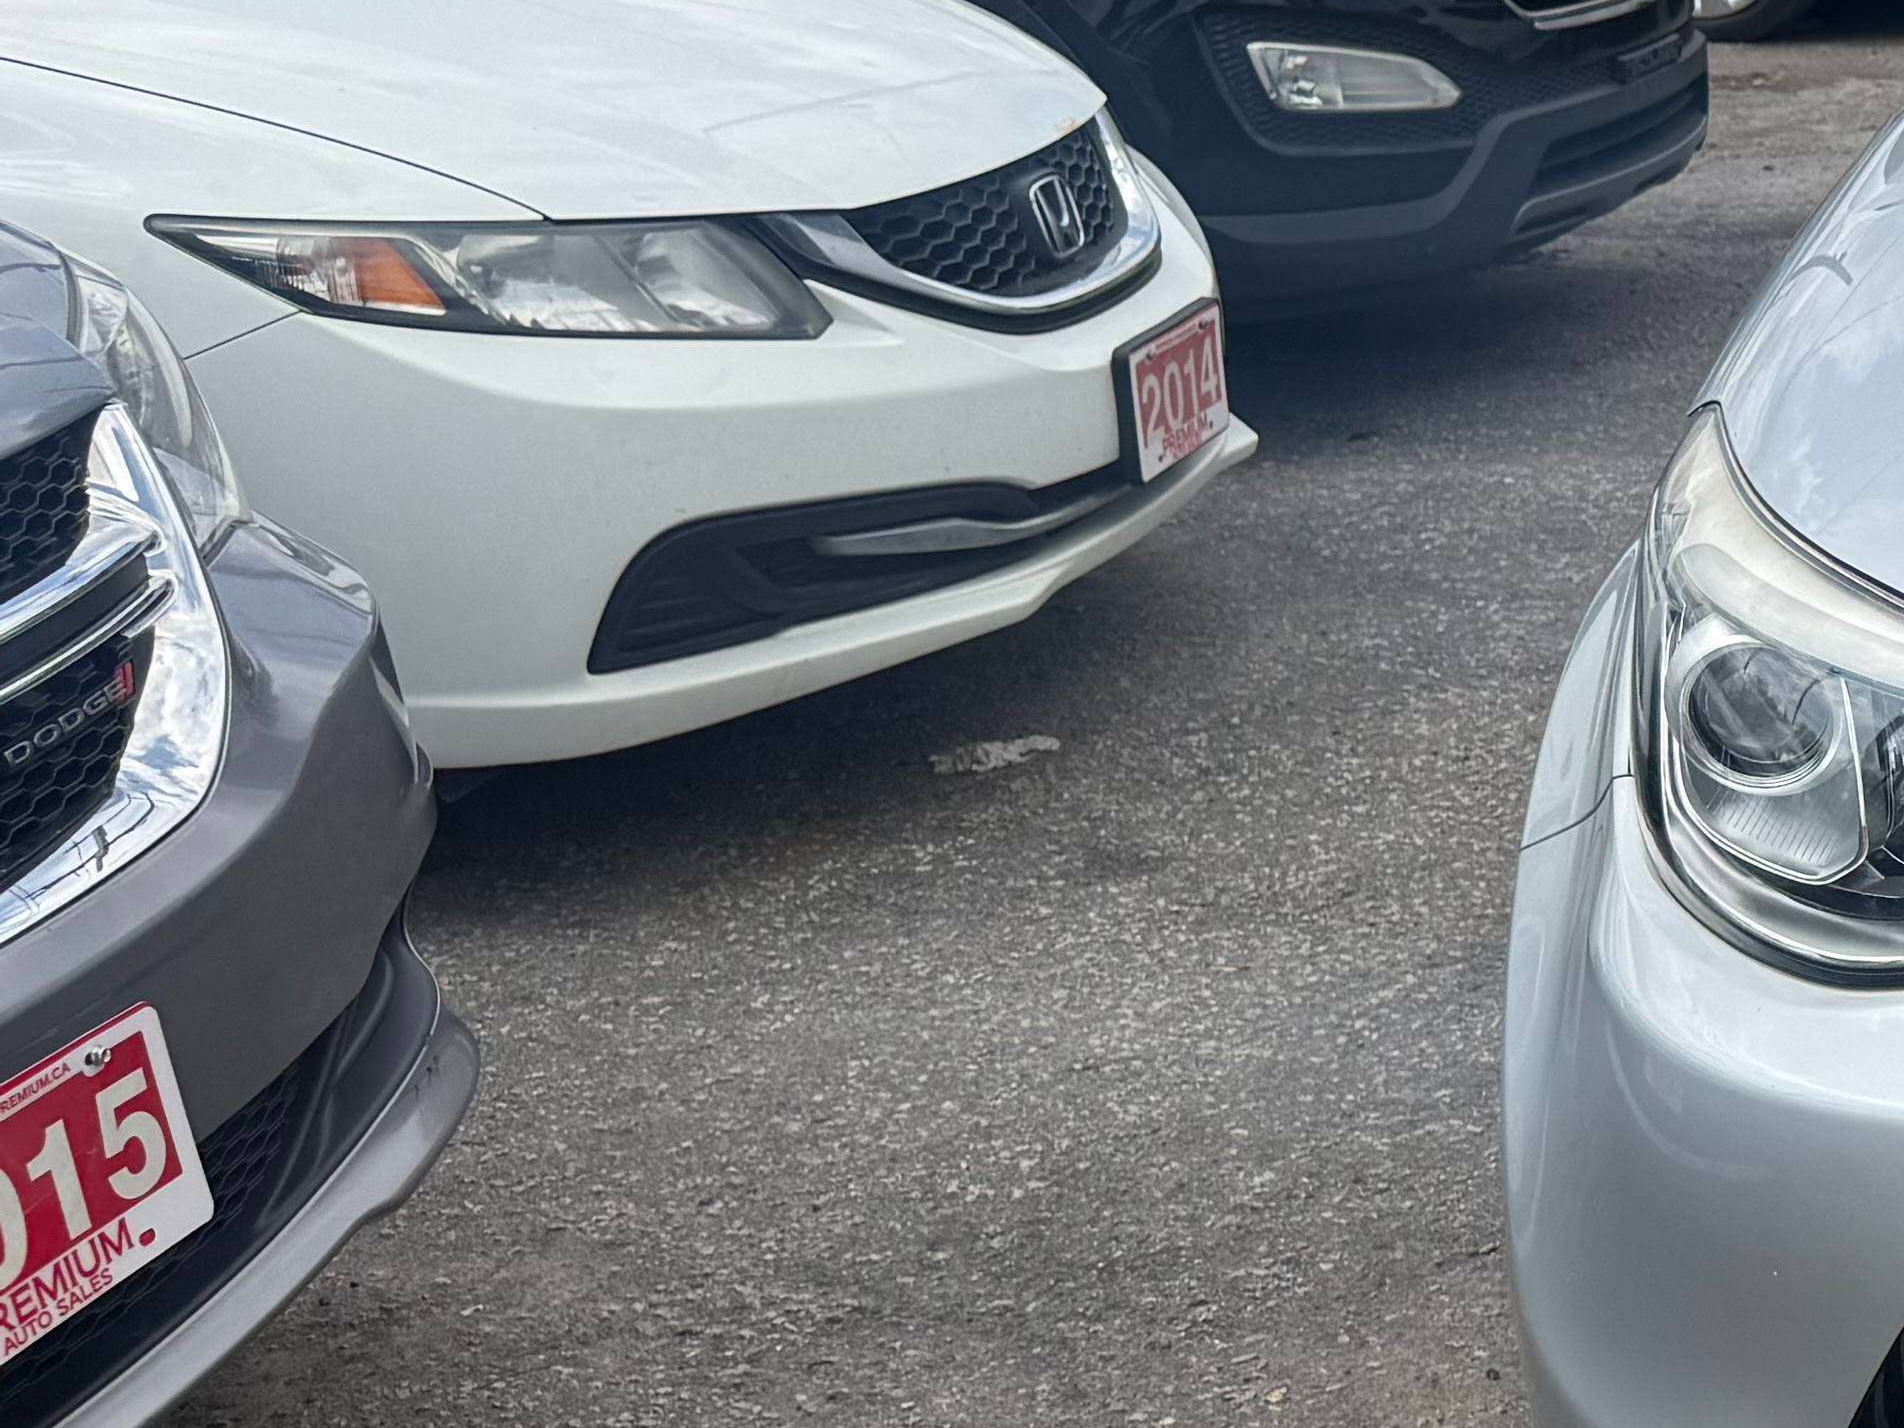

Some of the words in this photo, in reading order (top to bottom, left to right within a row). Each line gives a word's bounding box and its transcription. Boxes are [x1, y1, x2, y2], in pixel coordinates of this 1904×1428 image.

[1142, 335, 1219, 437] 2014
[4, 676, 128, 765] DODGE
[4, 1310, 53, 1357] AUTO
[59, 1268, 113, 1316] SALES
